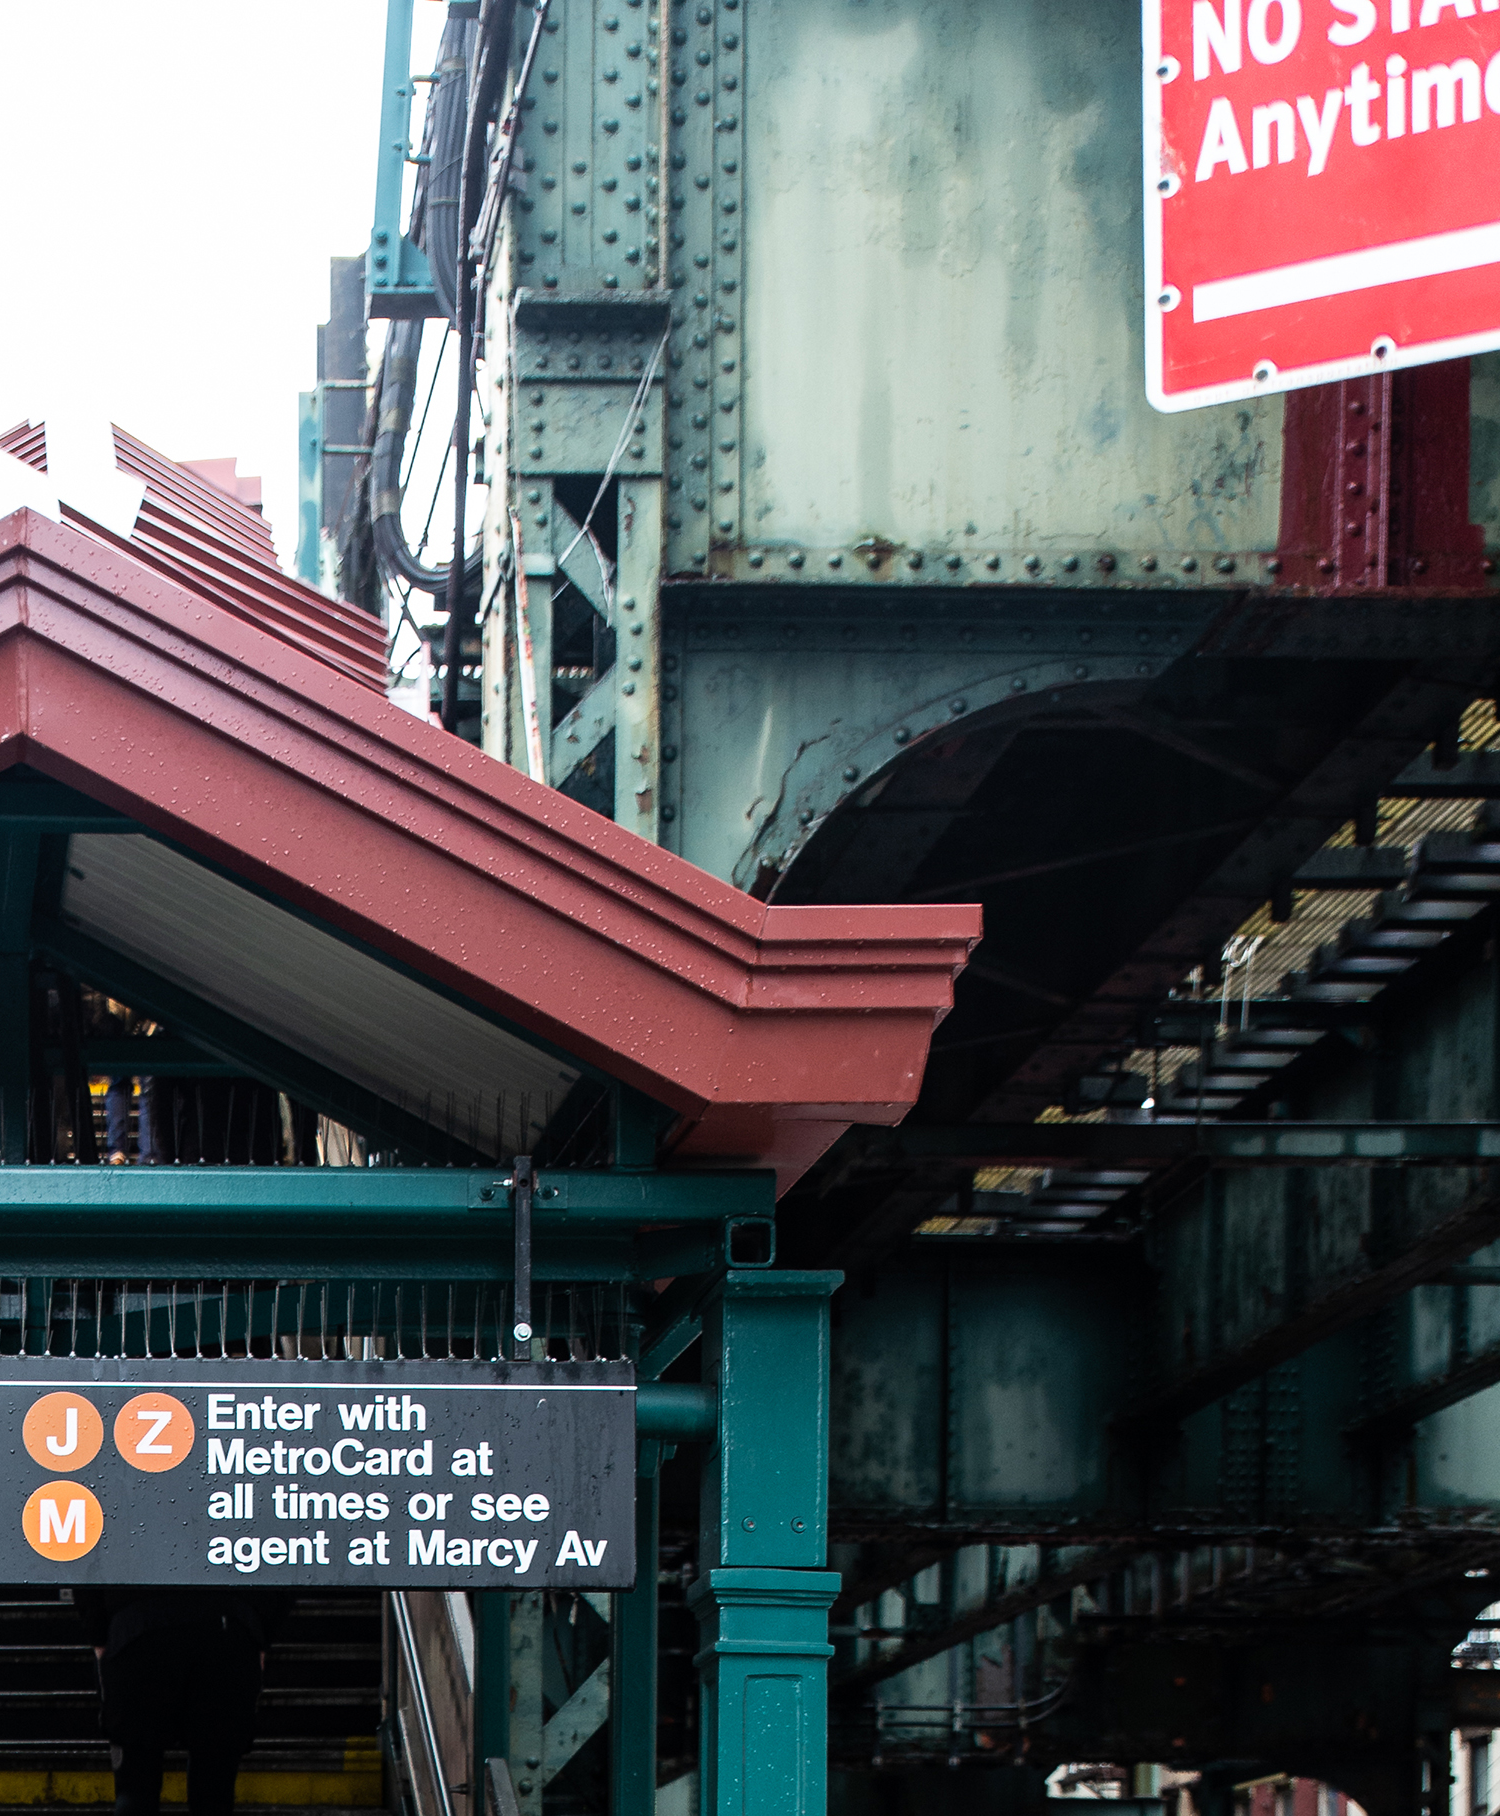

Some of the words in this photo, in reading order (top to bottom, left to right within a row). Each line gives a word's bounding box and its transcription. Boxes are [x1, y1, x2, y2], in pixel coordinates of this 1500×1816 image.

[1193, 0, 1302, 82] NO
[46, 1407, 78, 1457] J
[135, 1411, 173, 1454] Z
[207, 1394, 320, 1432] Enter
[338, 1394, 426, 1432] with
[207, 1439, 434, 1477] MetroCard
[451, 1442, 494, 1477] at
[38, 1500, 87, 1544] M
[207, 1483, 254, 1521] all
[273, 1483, 390, 1522] times
[408, 1491, 453, 1523] or
[470, 1492, 550, 1523] see
[207, 1530, 329, 1574] agent
[348, 1532, 390, 1567] at
[408, 1531, 539, 1575] Marcy
[555, 1532, 608, 1568] Av
